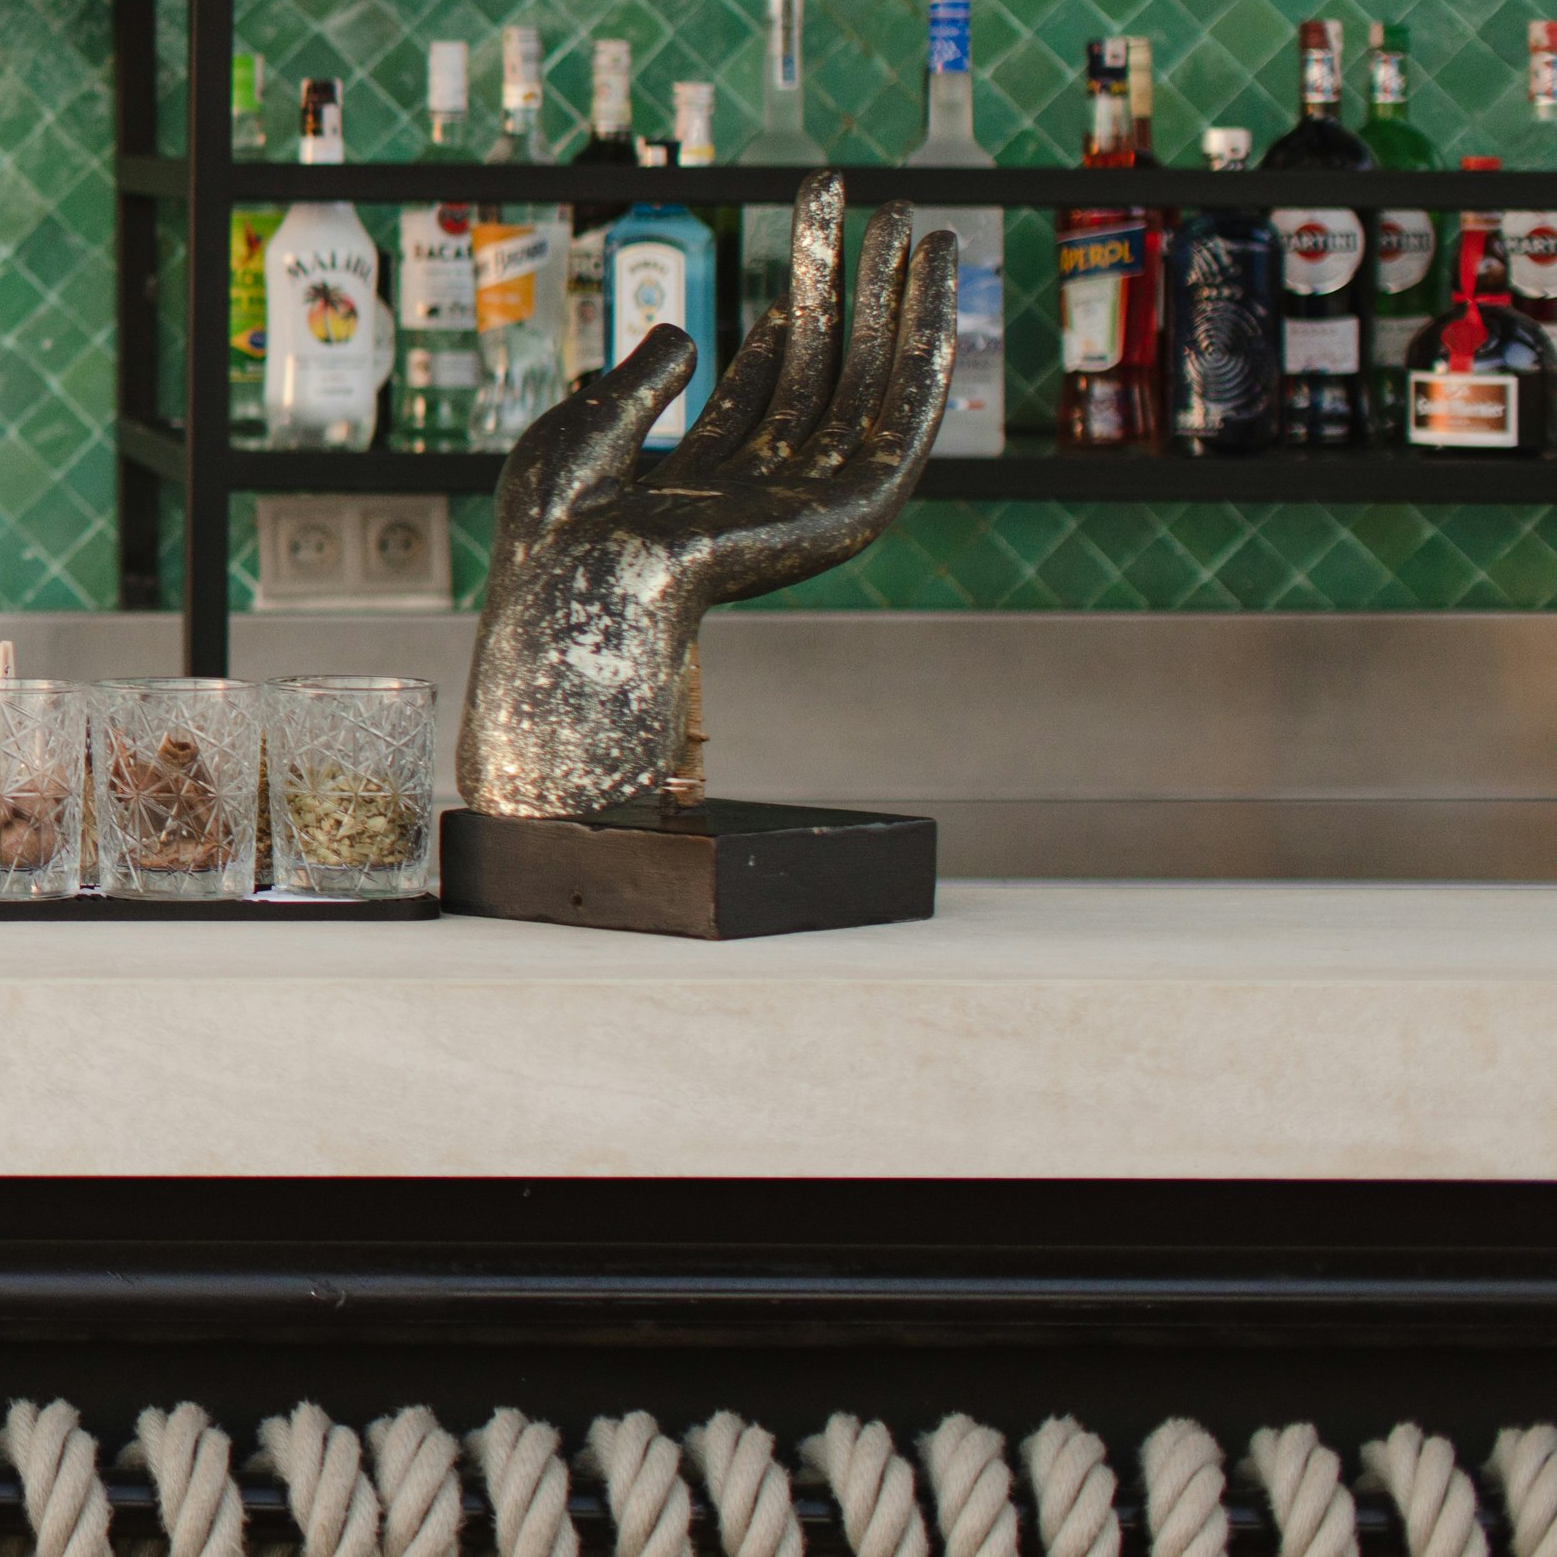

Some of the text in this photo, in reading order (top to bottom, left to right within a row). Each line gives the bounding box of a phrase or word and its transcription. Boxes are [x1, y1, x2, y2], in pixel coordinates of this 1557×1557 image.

[414, 244, 473, 261] BACA
[1059, 238, 1135, 274] APEROL
[1506, 235, 1557, 255] MART
[287, 249, 372, 284] MALIBU
